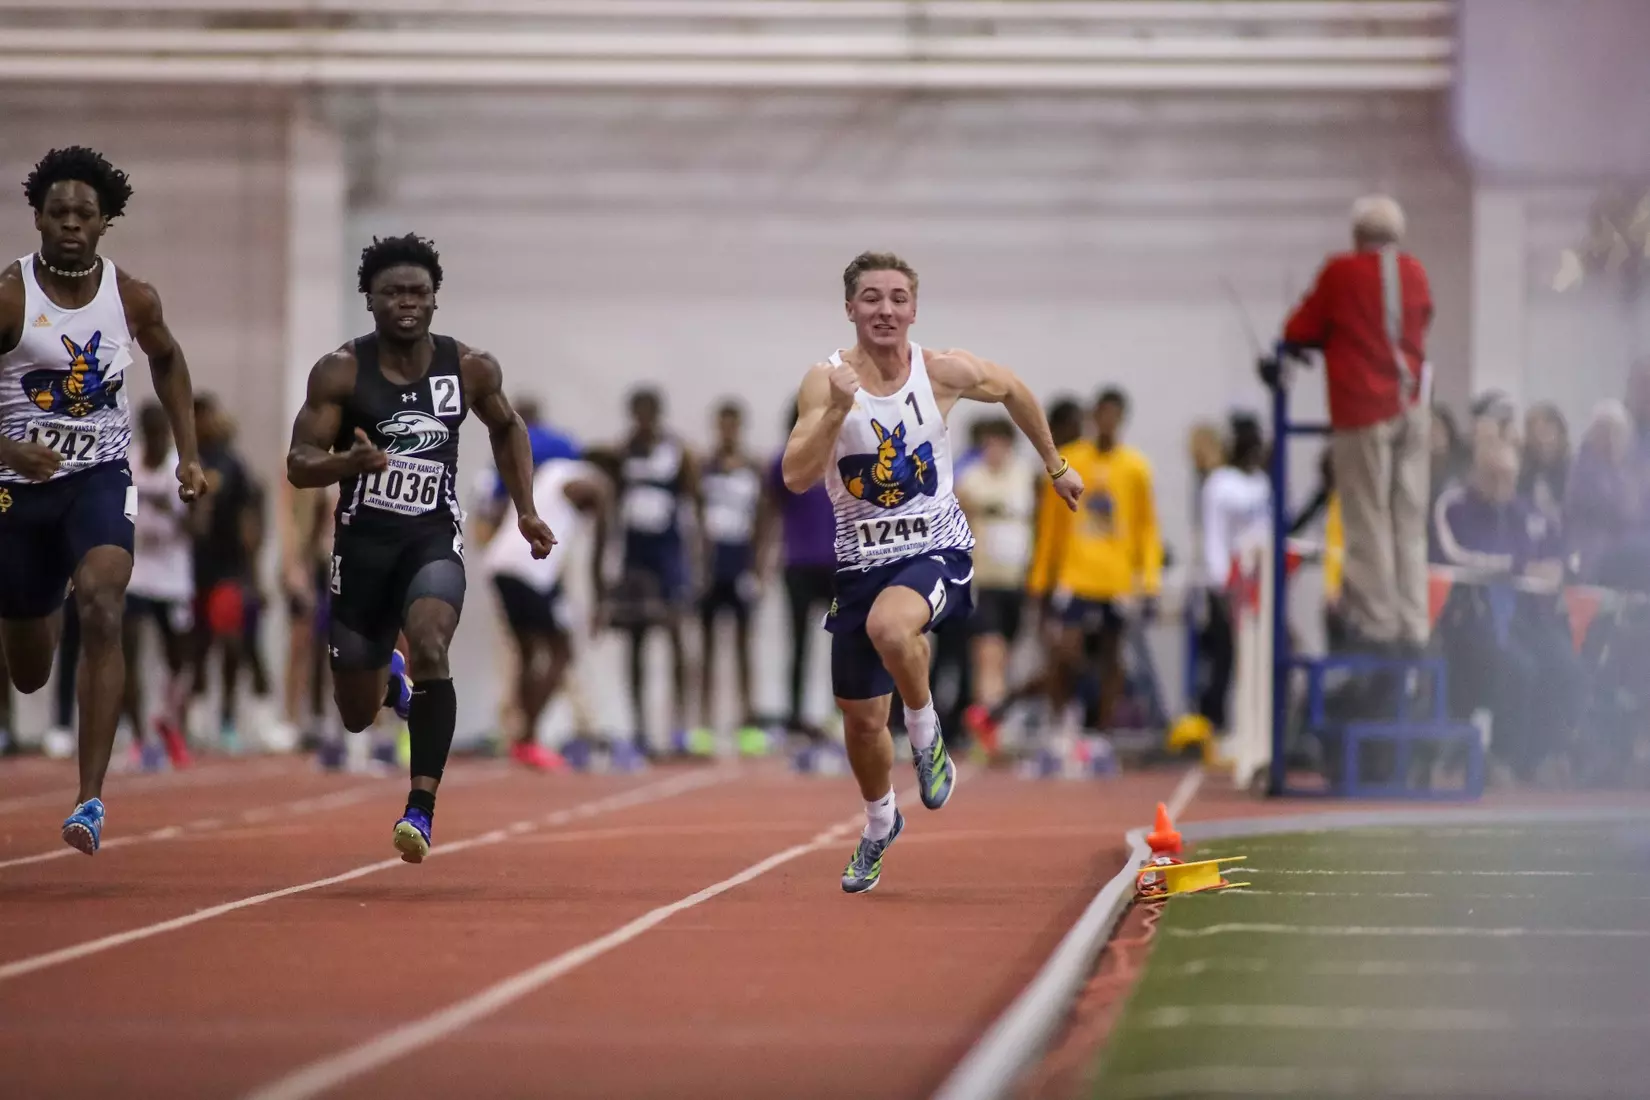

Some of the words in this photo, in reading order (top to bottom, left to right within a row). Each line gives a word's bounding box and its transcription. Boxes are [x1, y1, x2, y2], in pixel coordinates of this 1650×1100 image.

[435, 378, 457, 413] 2
[905, 391, 924, 425] 1
[74, 425, 97, 433] KANSAS
[29, 427, 96, 461] 1242
[388, 459, 407, 469] ERSITY
[417, 464, 440, 474] KANSAS
[369, 470, 438, 505] 1036
[368, 497, 393, 508] JAYHAWK
[860, 517, 929, 548] 1244
[866, 548, 892, 557] JAYHAWK
[935, 588, 945, 611] 1
